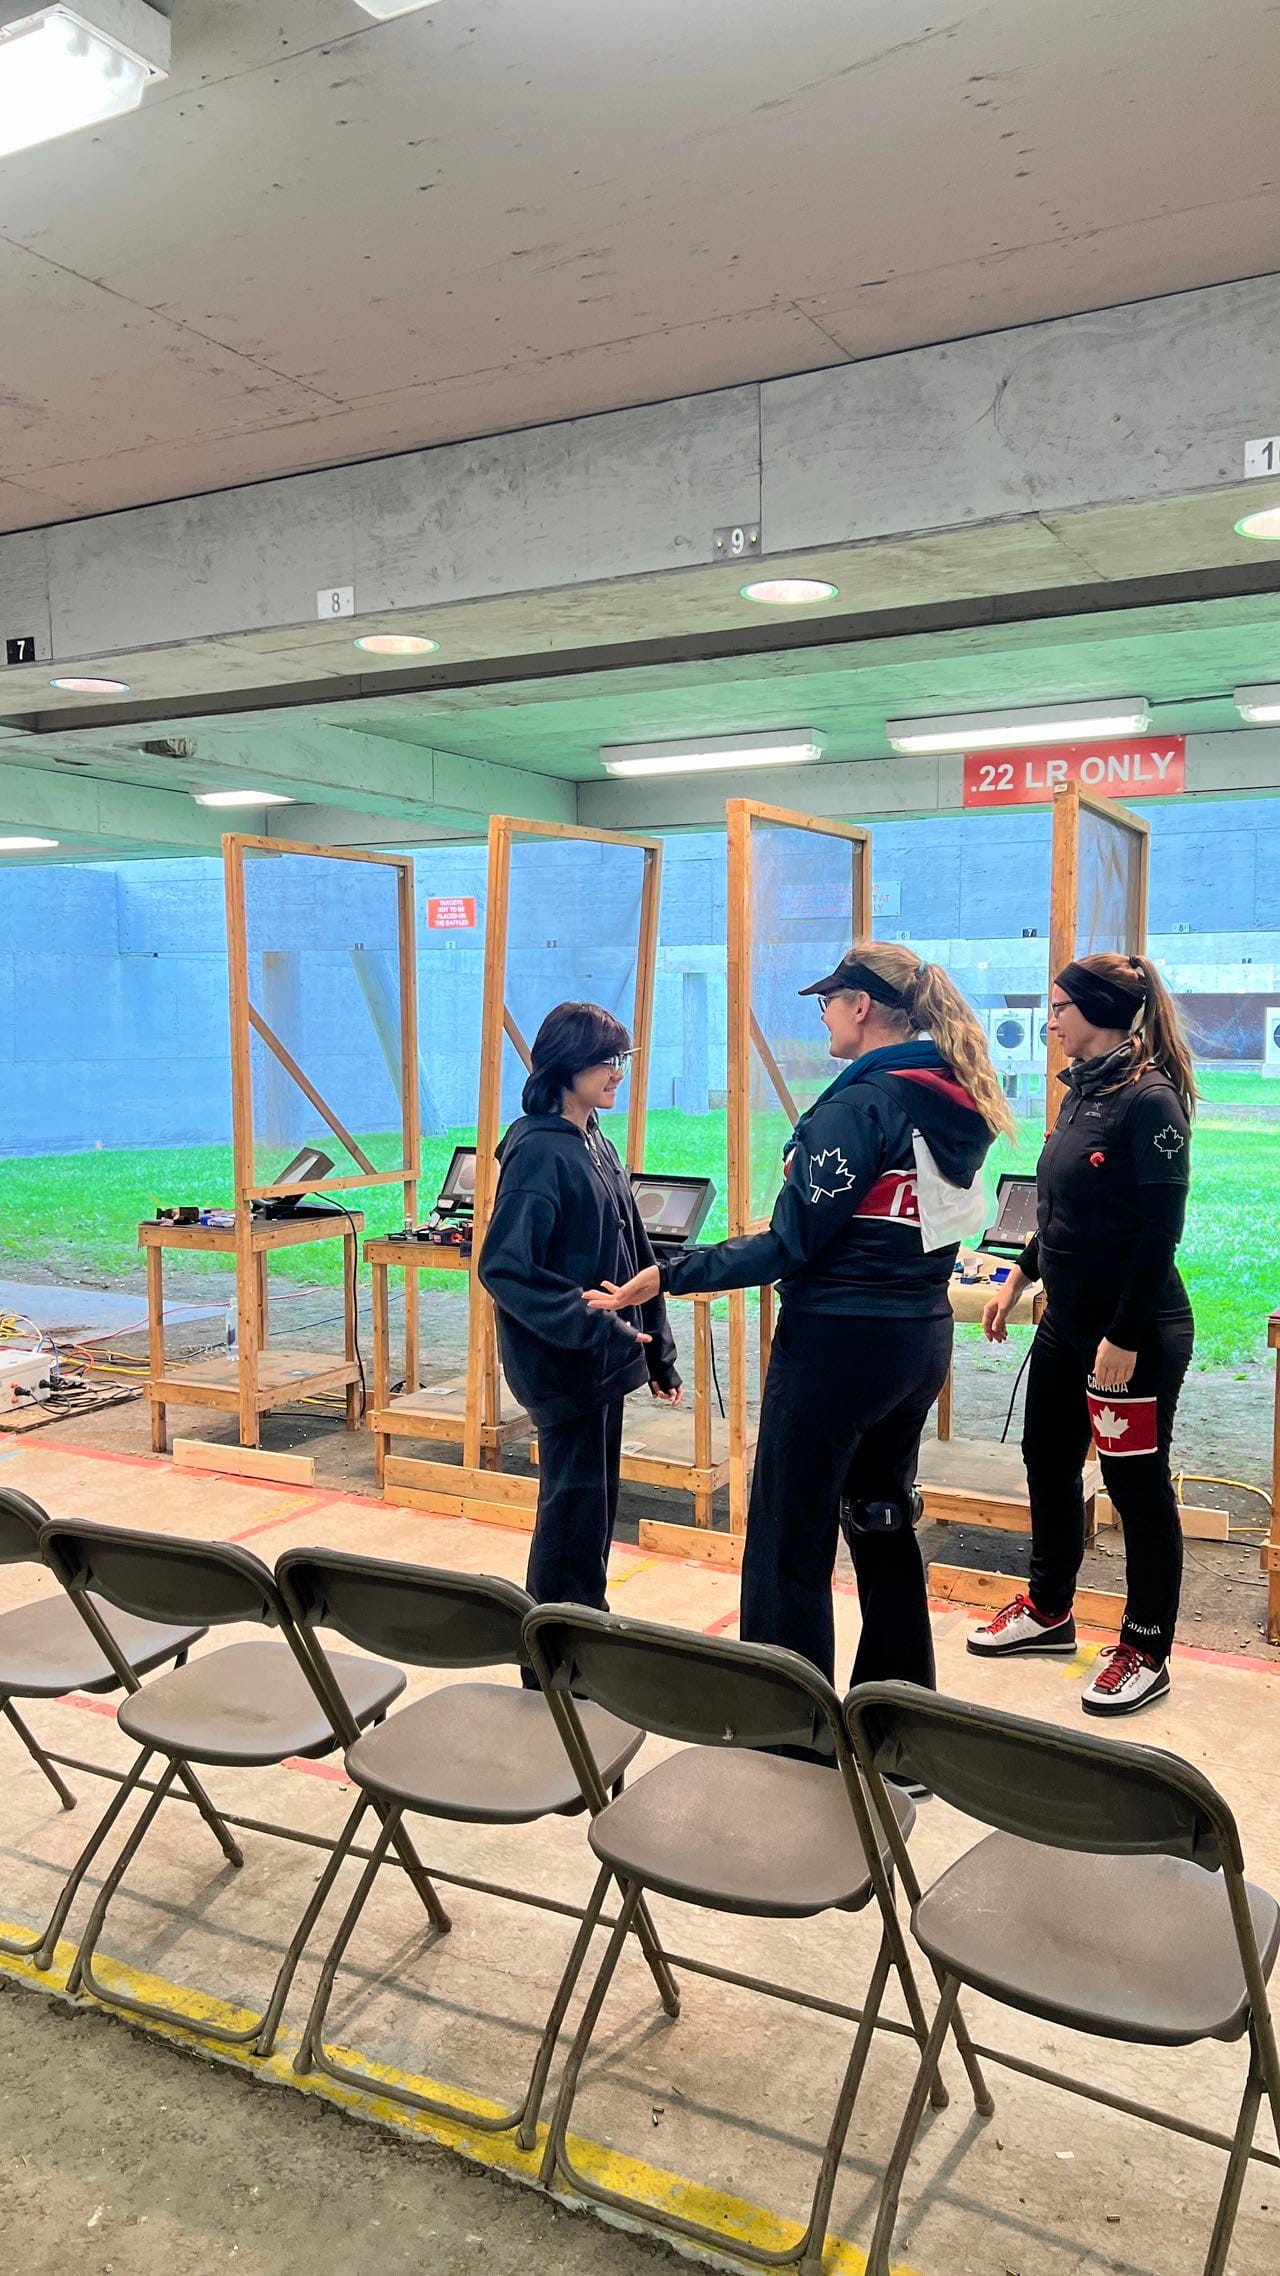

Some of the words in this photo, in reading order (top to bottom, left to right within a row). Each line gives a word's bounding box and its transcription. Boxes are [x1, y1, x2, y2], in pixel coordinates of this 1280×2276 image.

[1262, 441, 1280, 470] 1
[731, 527, 745, 554] 9
[331, 592, 340, 613] 8
[17, 640, 25, 660] 7
[970, 763, 1014, 792] .22
[1025, 760, 1069, 788] LR
[1080, 751, 1176, 785] ONLY
